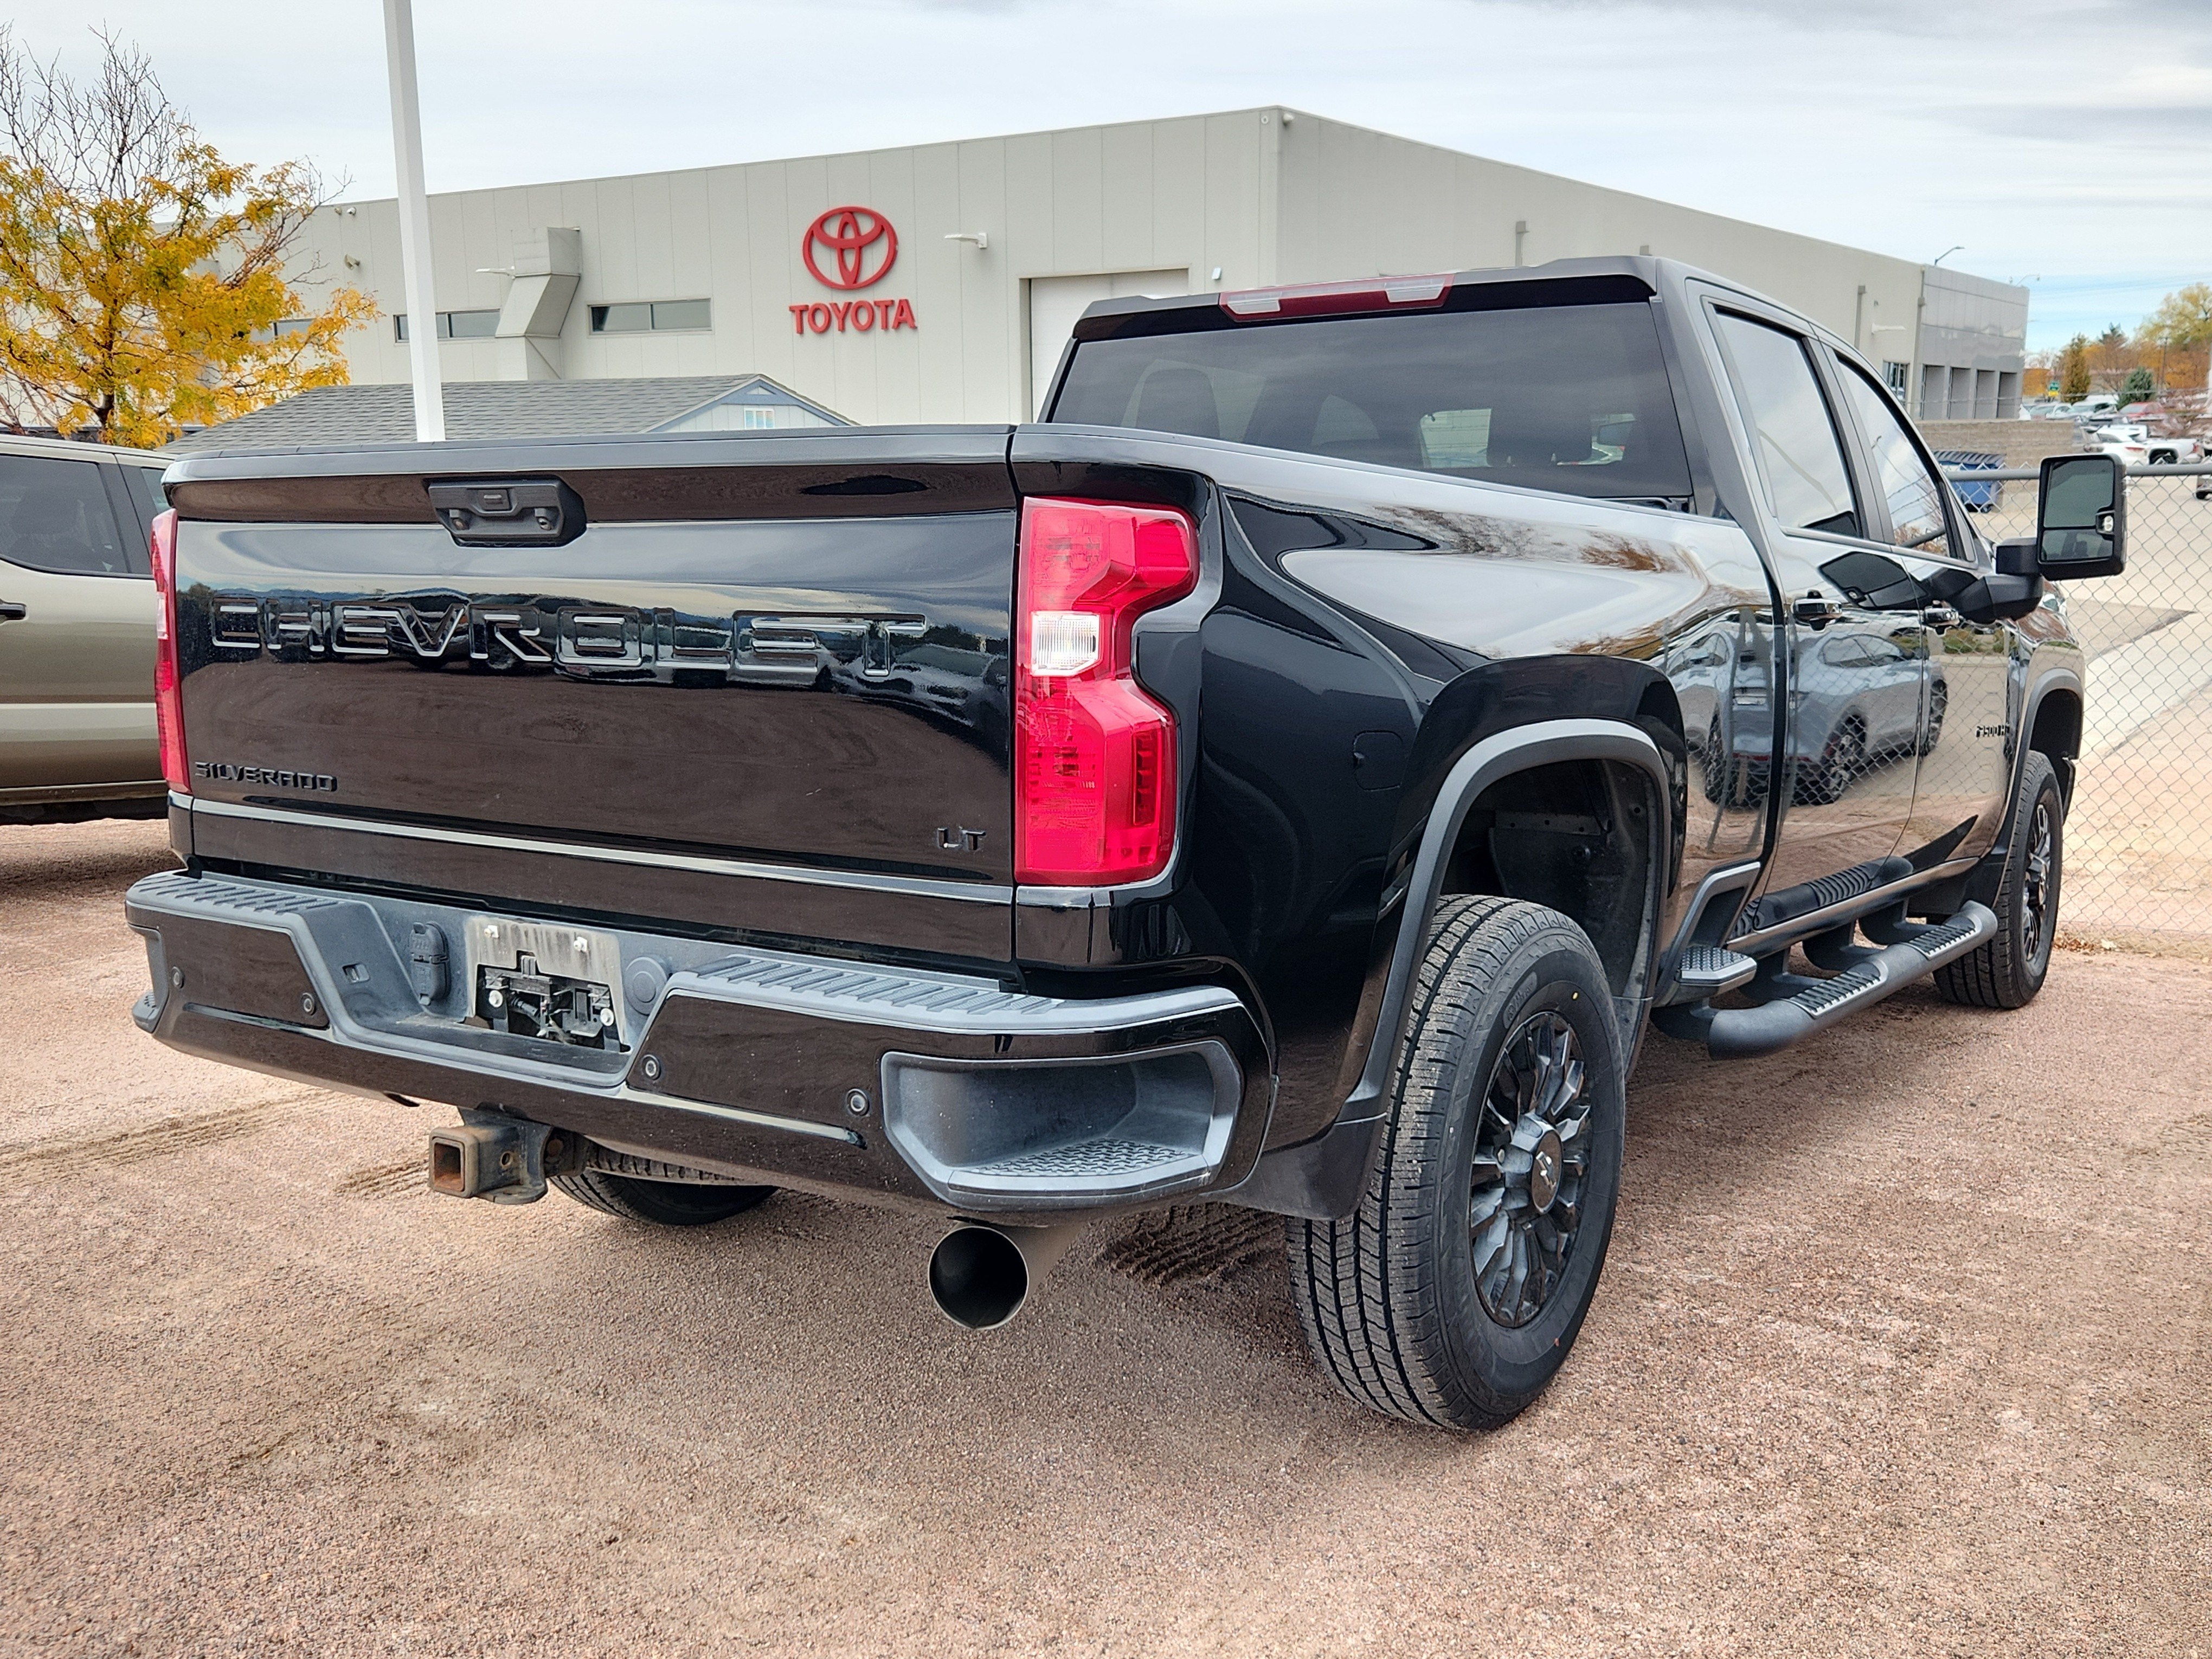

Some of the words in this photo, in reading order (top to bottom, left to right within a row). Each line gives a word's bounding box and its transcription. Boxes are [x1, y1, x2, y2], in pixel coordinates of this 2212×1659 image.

[788, 299, 917, 335] TOYOTA
[210, 597, 927, 677] CHEVROLET
[194, 760, 338, 793] SILVERADO
[937, 826, 986, 852] LT
